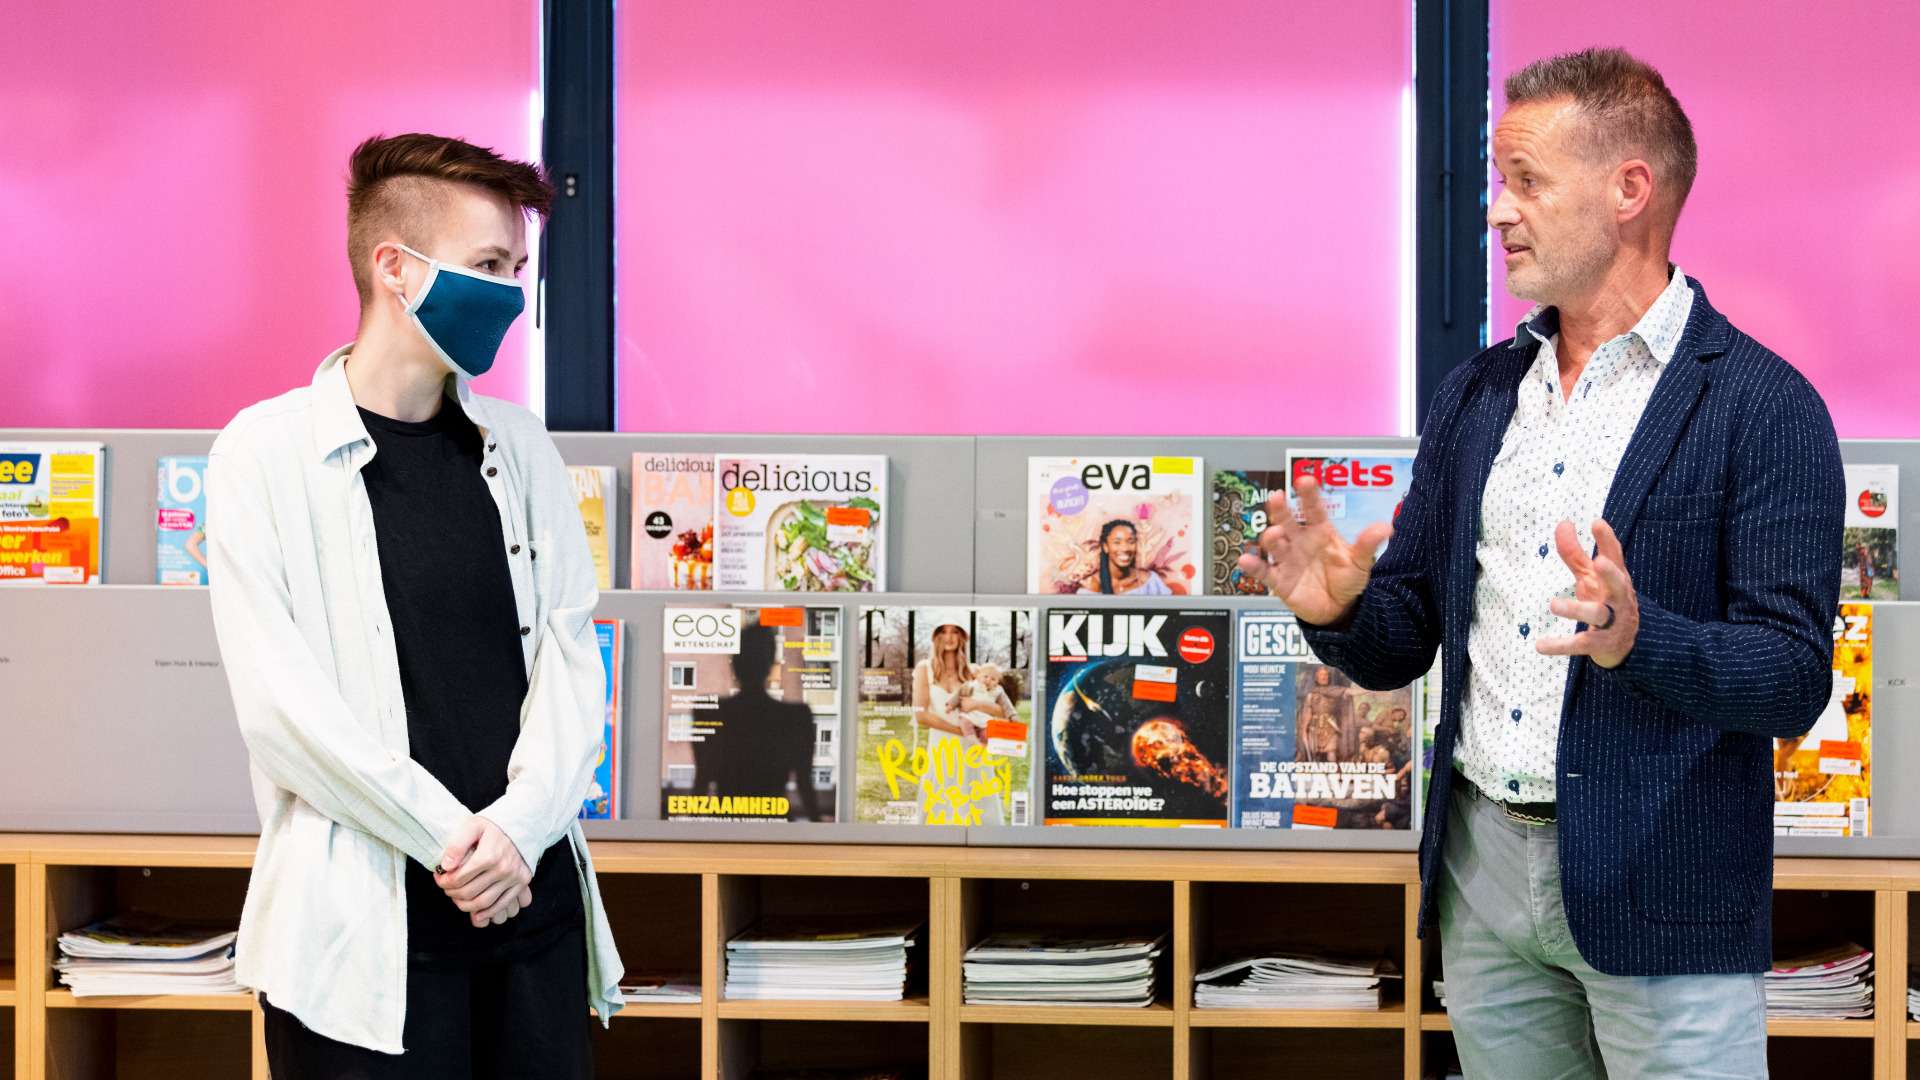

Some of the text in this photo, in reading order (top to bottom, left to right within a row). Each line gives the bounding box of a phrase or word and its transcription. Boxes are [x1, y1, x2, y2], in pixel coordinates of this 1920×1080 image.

[645, 458, 714, 473] deliciou
[1293, 459, 1394, 487] fiets
[1081, 464, 1150, 490] eva
[0, 534, 26, 549] er
[673, 614, 736, 637] eos
[1049, 614, 1169, 656] KIJK
[1260, 762, 1386, 774] DE OPSTAND VAN DE
[1052, 784, 1152, 799] Hoe stoppen we
[1249, 773, 1397, 799] BATAVEN
[668, 795, 790, 815] EENZAAMHEID
[1052, 796, 1165, 811] een ASTEROÏDE?
